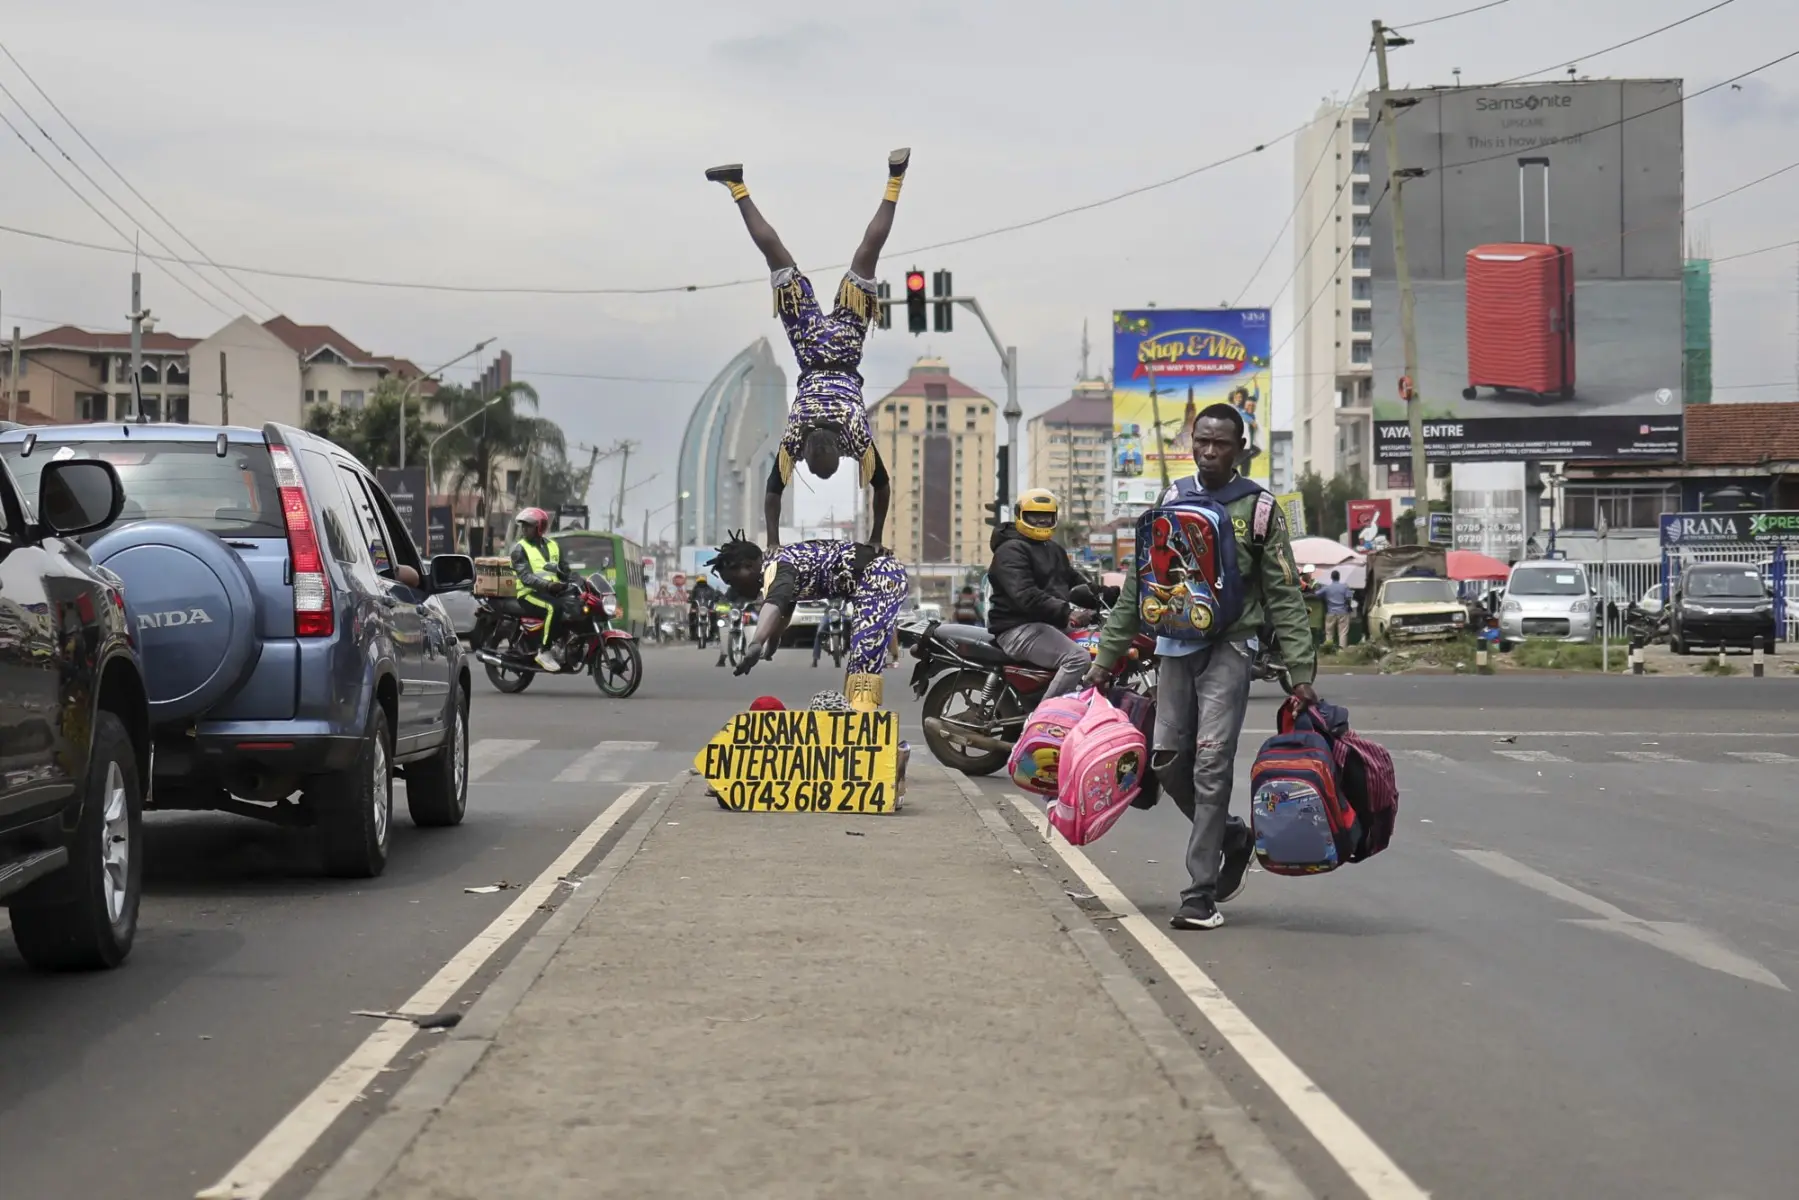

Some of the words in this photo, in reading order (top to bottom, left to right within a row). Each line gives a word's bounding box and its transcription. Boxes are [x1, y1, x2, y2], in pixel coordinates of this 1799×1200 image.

[1476, 95, 1572, 110] Samsonite
[1468, 136, 1493, 149] This
[1496, 136, 1505, 148] is
[1508, 135, 1536, 147] how
[1138, 340, 1184, 363] Shop
[1187, 336, 1203, 356] &
[1203, 336, 1246, 361] Win
[1197, 363, 1235, 371] THAILAND
[1380, 426, 1411, 438] YAYA
[1423, 425, 1464, 437] ENTRE
[1683, 517, 1737, 534] RANA
[136, 607, 213, 630] NDA
[732, 711, 820, 745] BUSAKA
[828, 711, 891, 745] TEAM
[705, 744, 882, 780] ENTERTAINMET
[729, 782, 789, 811] 0743
[794, 782, 833, 811] 618
[837, 782, 886, 811] 274
